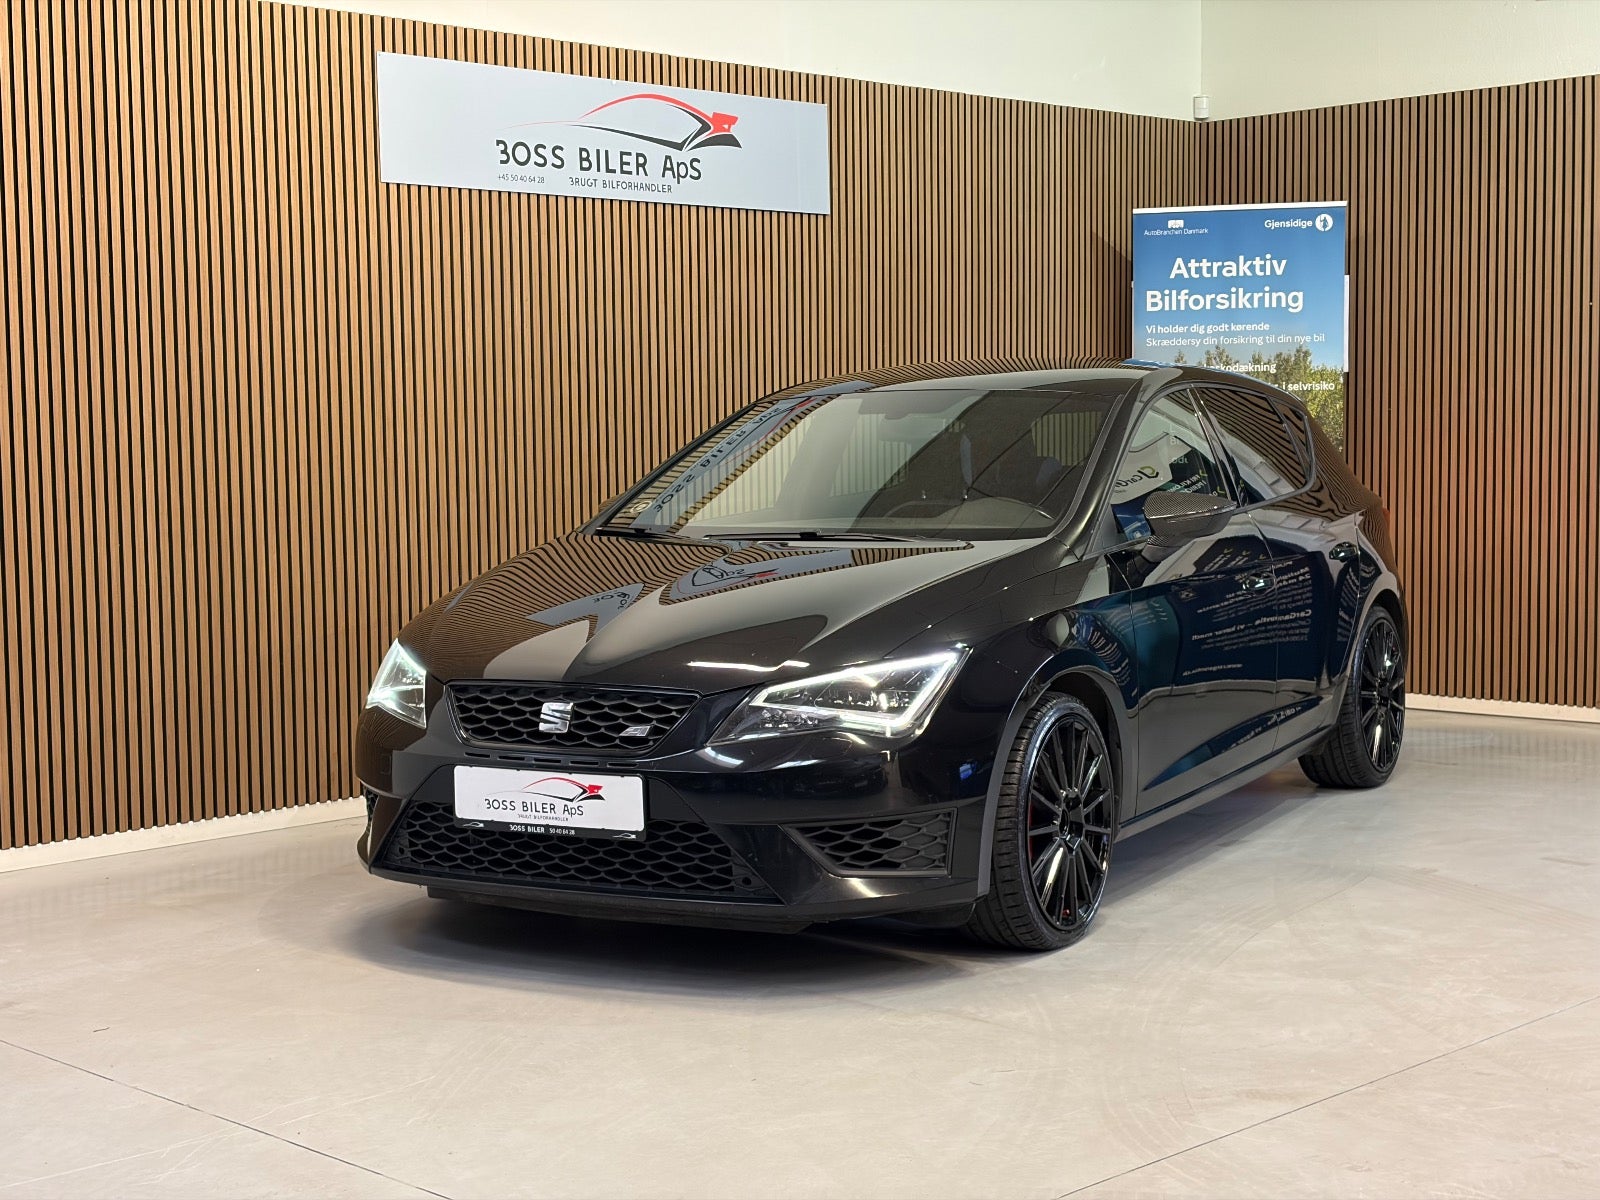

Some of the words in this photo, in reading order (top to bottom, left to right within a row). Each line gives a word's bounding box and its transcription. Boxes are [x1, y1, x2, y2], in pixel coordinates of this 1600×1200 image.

[496, 139, 565, 169] BOSS
[579, 147, 648, 177] BILER
[662, 155, 701, 184] ApS
[511, 174, 518, 182] 50
[520, 175, 527, 183] 40
[537, 176, 545, 184] 28
[569, 176, 598, 187] BRUGT
[602, 179, 672, 193] BILFORHANDLER
[1264, 218, 1313, 230] Gjensidige
[1169, 253, 1287, 279] Attraktiv
[1146, 286, 1304, 313] Bilforsikring
[1145, 324, 1156, 334] Vi
[1157, 324, 1188, 334] holder
[1190, 323, 1205, 334] dig
[1206, 323, 1230, 334] godt
[1231, 321, 1270, 332] kørende
[1146, 337, 1201, 348] Skræddersy
[1203, 336, 1218, 345] din
[1220, 334, 1264, 346] forsikring
[1265, 334, 1275, 343] til
[1277, 333, 1292, 343] din
[1294, 335, 1312, 344] nye
[1313, 333, 1325, 342] bil
[1282, 381, 1286, 390] i
[1288, 382, 1335, 391] selvrisiko
[522, 801, 556, 814] BILER
[562, 804, 584, 817] ApS
[527, 825, 545, 834] BILER
